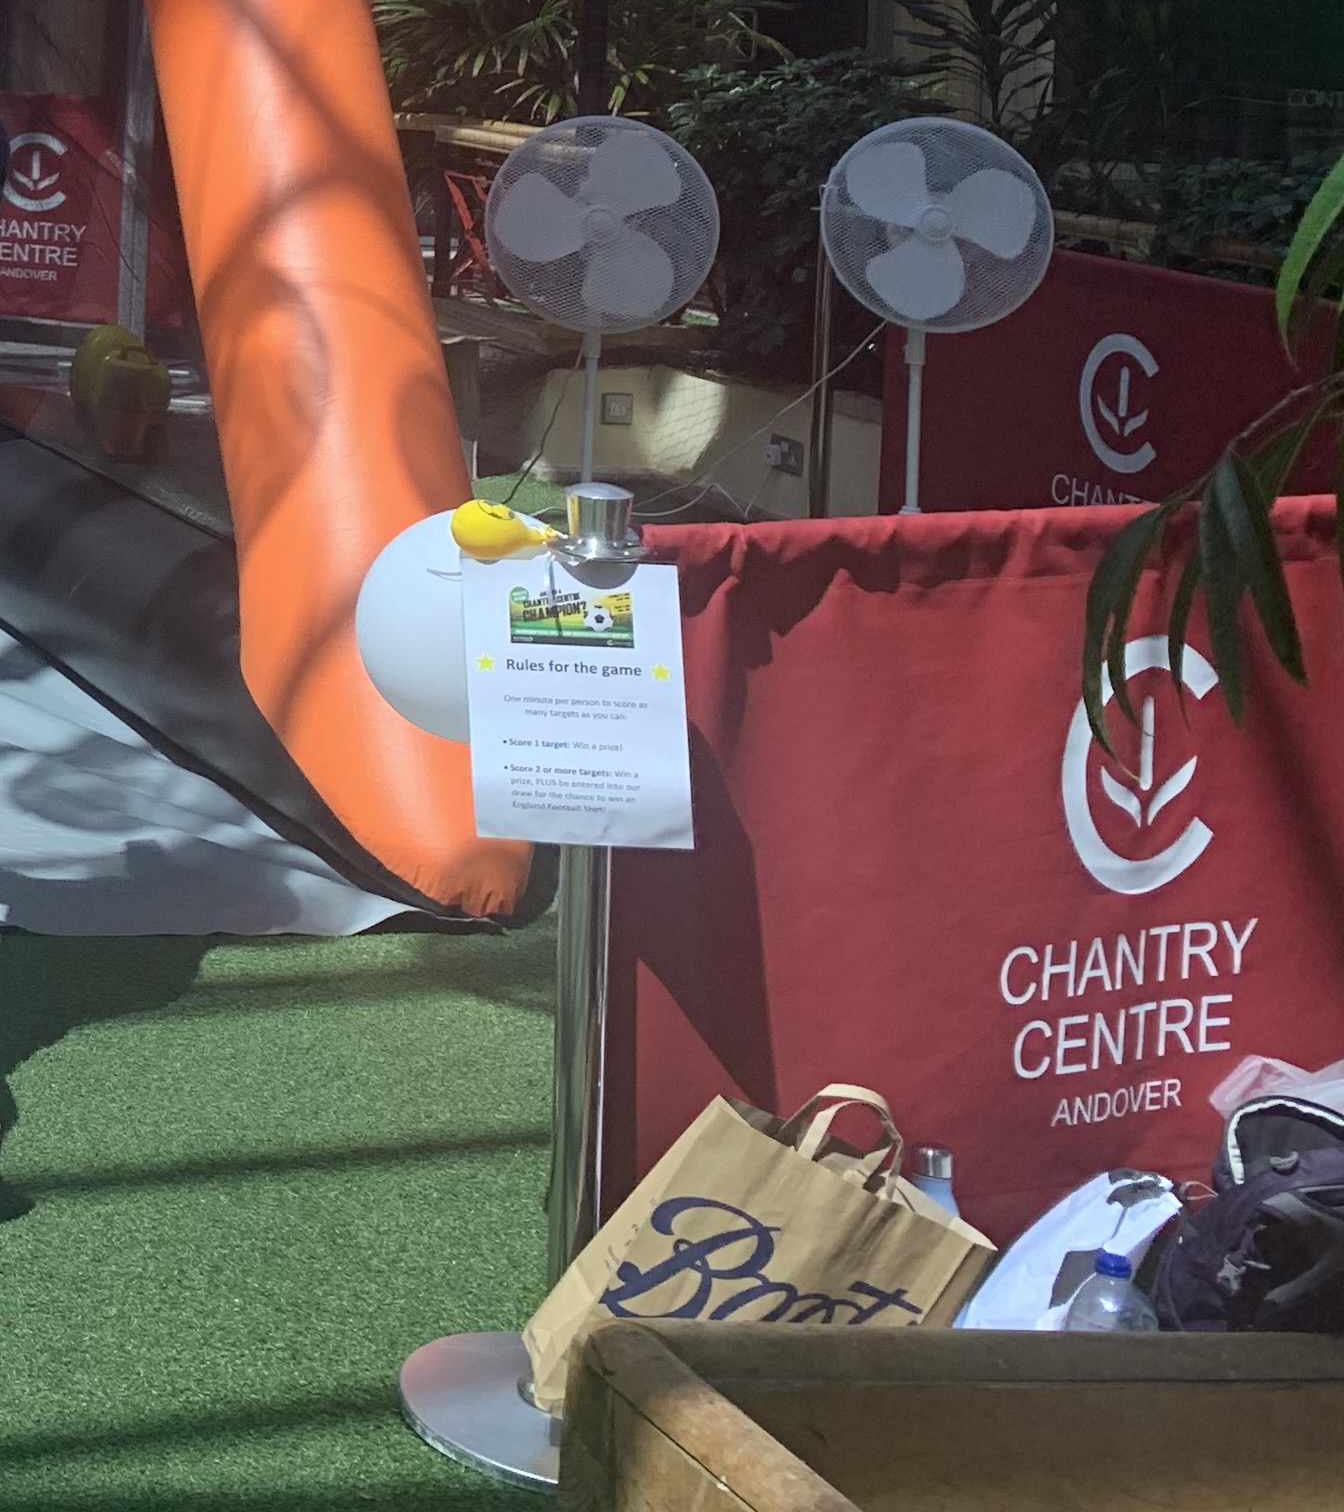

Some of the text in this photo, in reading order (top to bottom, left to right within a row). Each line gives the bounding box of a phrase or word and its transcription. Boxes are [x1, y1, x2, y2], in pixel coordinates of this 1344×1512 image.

[0, 266, 58, 282] ANDOVER
[506, 659, 642, 678] Rules for the game
[504, 695, 521, 703] One
[523, 695, 553, 704] minute
[555, 698, 569, 706] per
[571, 698, 600, 707] person
[638, 701, 648, 709] as
[524, 708, 547, 718] many
[550, 709, 579, 719] targets
[593, 712, 608, 721] you
[509, 738, 532, 747] Score
[541, 739, 570, 750] target:
[572, 741, 590, 749] Win
[510, 764, 533, 773] Score
[536, 765, 541, 773] 2
[554, 767, 577, 775] more
[579, 767, 612, 778] targets:
[614, 769, 631, 778] Win
[535, 779, 557, 787] PLUS
[558, 779, 569, 787] be
[571, 780, 605, 789] entered
[607, 781, 624, 790] into
[511, 789, 533, 797] draw
[549, 790, 562, 799] the
[565, 792, 595, 801] chance
[597, 794, 606, 802] to
[608, 795, 624, 803] win
[512, 800, 545, 810] England
[547, 803, 581, 812] Football
[1000, 918, 1258, 1005] CHANTRY
[1014, 994, 1233, 1079] CENTRE
[1050, 1078, 1182, 1128] ANDOVER
[599, 1196, 923, 1326] Boot
